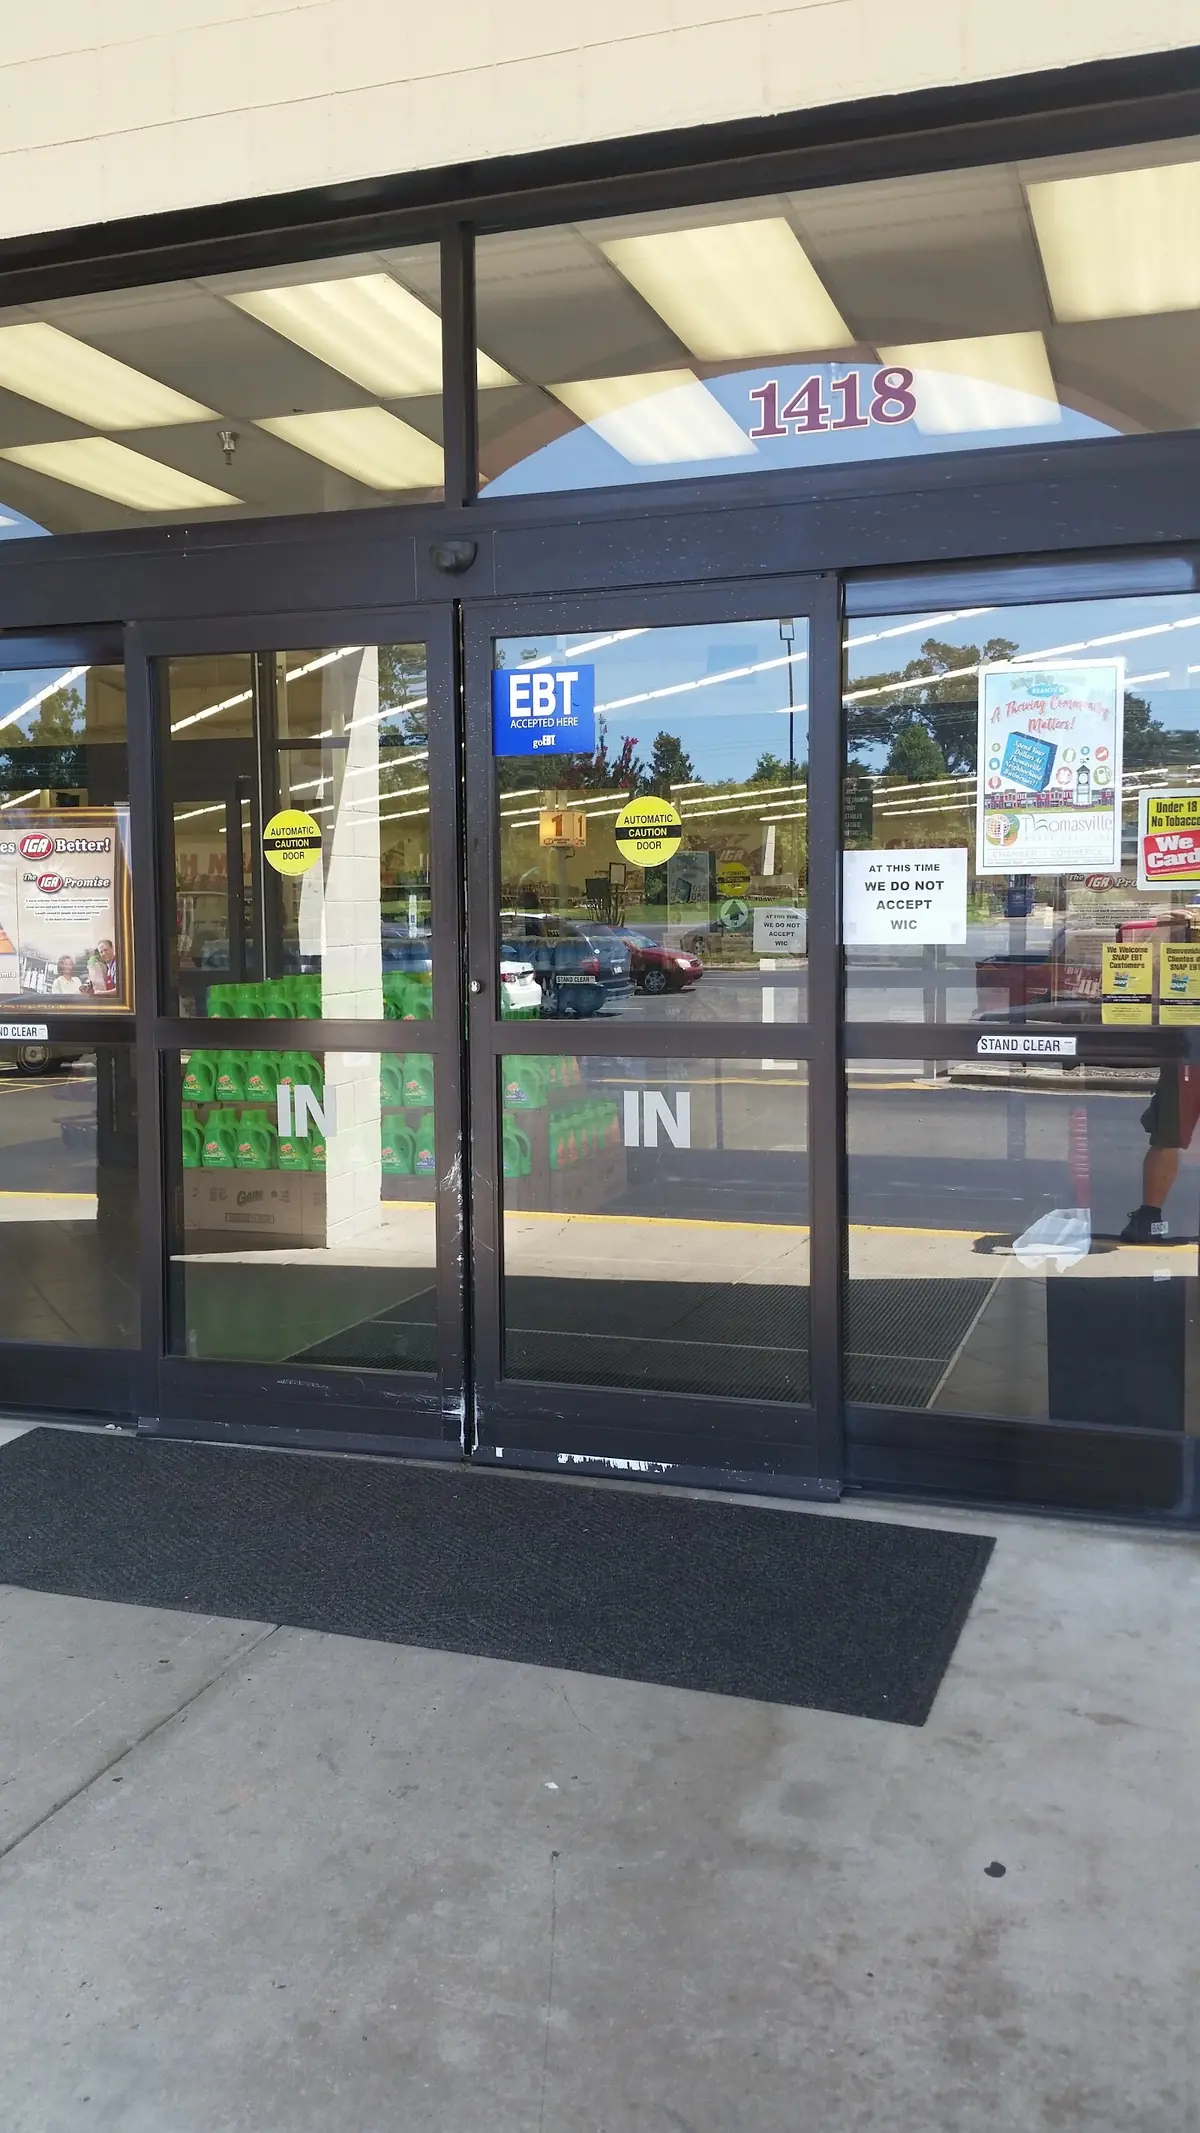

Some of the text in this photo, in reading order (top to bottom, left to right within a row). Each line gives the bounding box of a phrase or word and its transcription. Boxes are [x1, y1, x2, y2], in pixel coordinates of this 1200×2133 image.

[749, 366, 917, 440] 1418
[509, 671, 578, 718] EBT
[1005, 699, 1046, 717] Thriving
[510, 717, 578, 729] ACCEPTED HERE
[1028, 717, 1076, 733] Matters!
[1156, 801, 1198, 813] Under 18
[624, 814, 673, 824] AUTOMATIC
[1022, 814, 1113, 832] Thomasville
[1151, 816, 1163, 827] No
[271, 826, 314, 836] AUTOMATIC
[552, 814, 563, 837] 1
[577, 815, 583, 837] 1
[628, 827, 667, 837] CAUTION
[22, 838, 49, 853] IGA
[55, 838, 111, 853] Better!
[275, 839, 309, 848] CAUTION
[636, 841, 662, 850] DOOR
[1154, 835, 1194, 852] We
[282, 851, 305, 860] DOOR
[1147, 848, 1200, 868] Card
[868, 864, 940, 872] AT THIS TIME
[23, 873, 110, 888] The IGA Promise
[865, 880, 945, 891] WE DO NOT
[1087, 876, 1110, 887] IGA
[876, 899, 933, 910] ACCEPT
[890, 920, 918, 930] WIC
[11, 1026, 38, 1037] CLEAR
[981, 1039, 1060, 1051] STAND CLEAR
[276, 1085, 337, 1137] IN
[623, 1090, 690, 1148] IN
